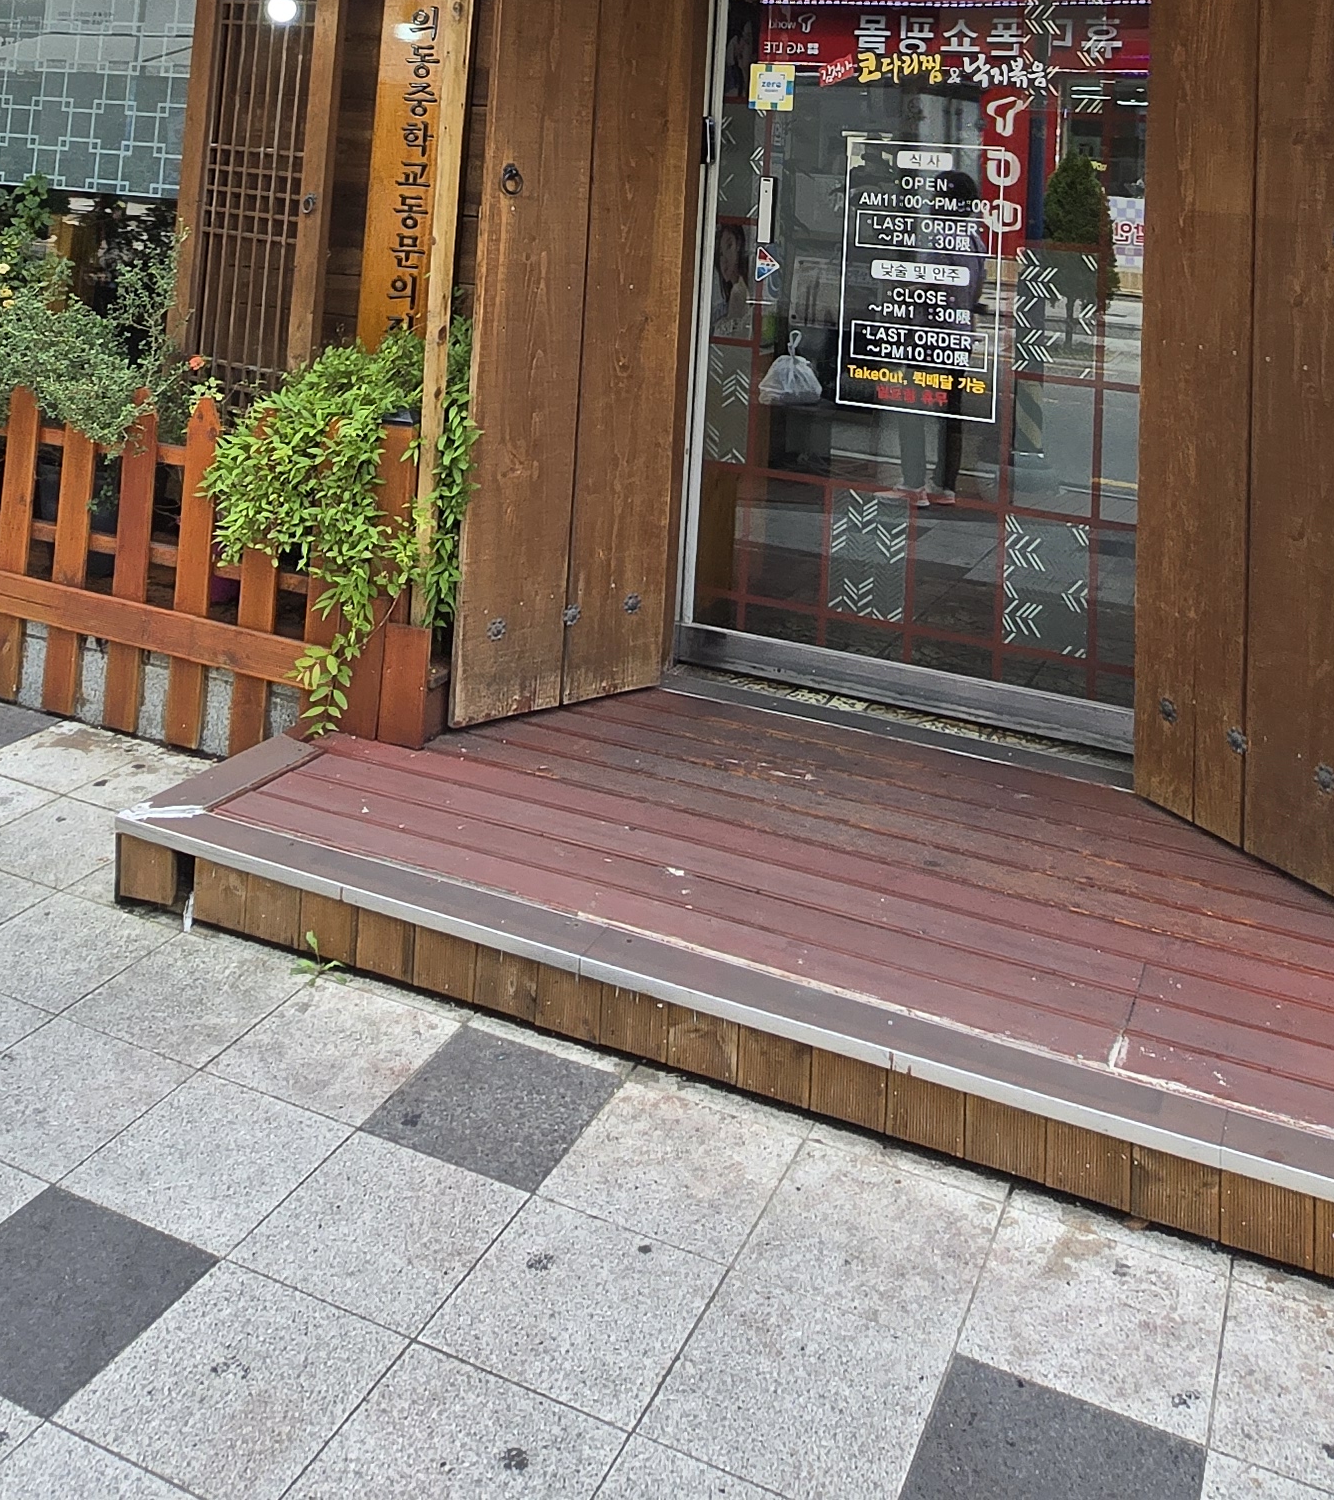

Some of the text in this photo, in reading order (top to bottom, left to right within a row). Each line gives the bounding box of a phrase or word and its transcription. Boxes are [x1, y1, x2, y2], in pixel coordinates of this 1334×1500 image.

[857, 52, 942, 84] 코다리찜
[947, 68, 961, 83] &
[963, 54, 1047, 88] 낙지볶음
[901, 177, 948, 191] OPEN
[873, 216, 978, 235] LAST ORDER
[881, 263, 960, 282] 낮술 및 안주
[893, 288, 947, 305] CLOSE
[866, 326, 971, 349] LAST ORDER
[913, 371, 953, 390] 퀵배달
[958, 377, 986, 393] 가능
